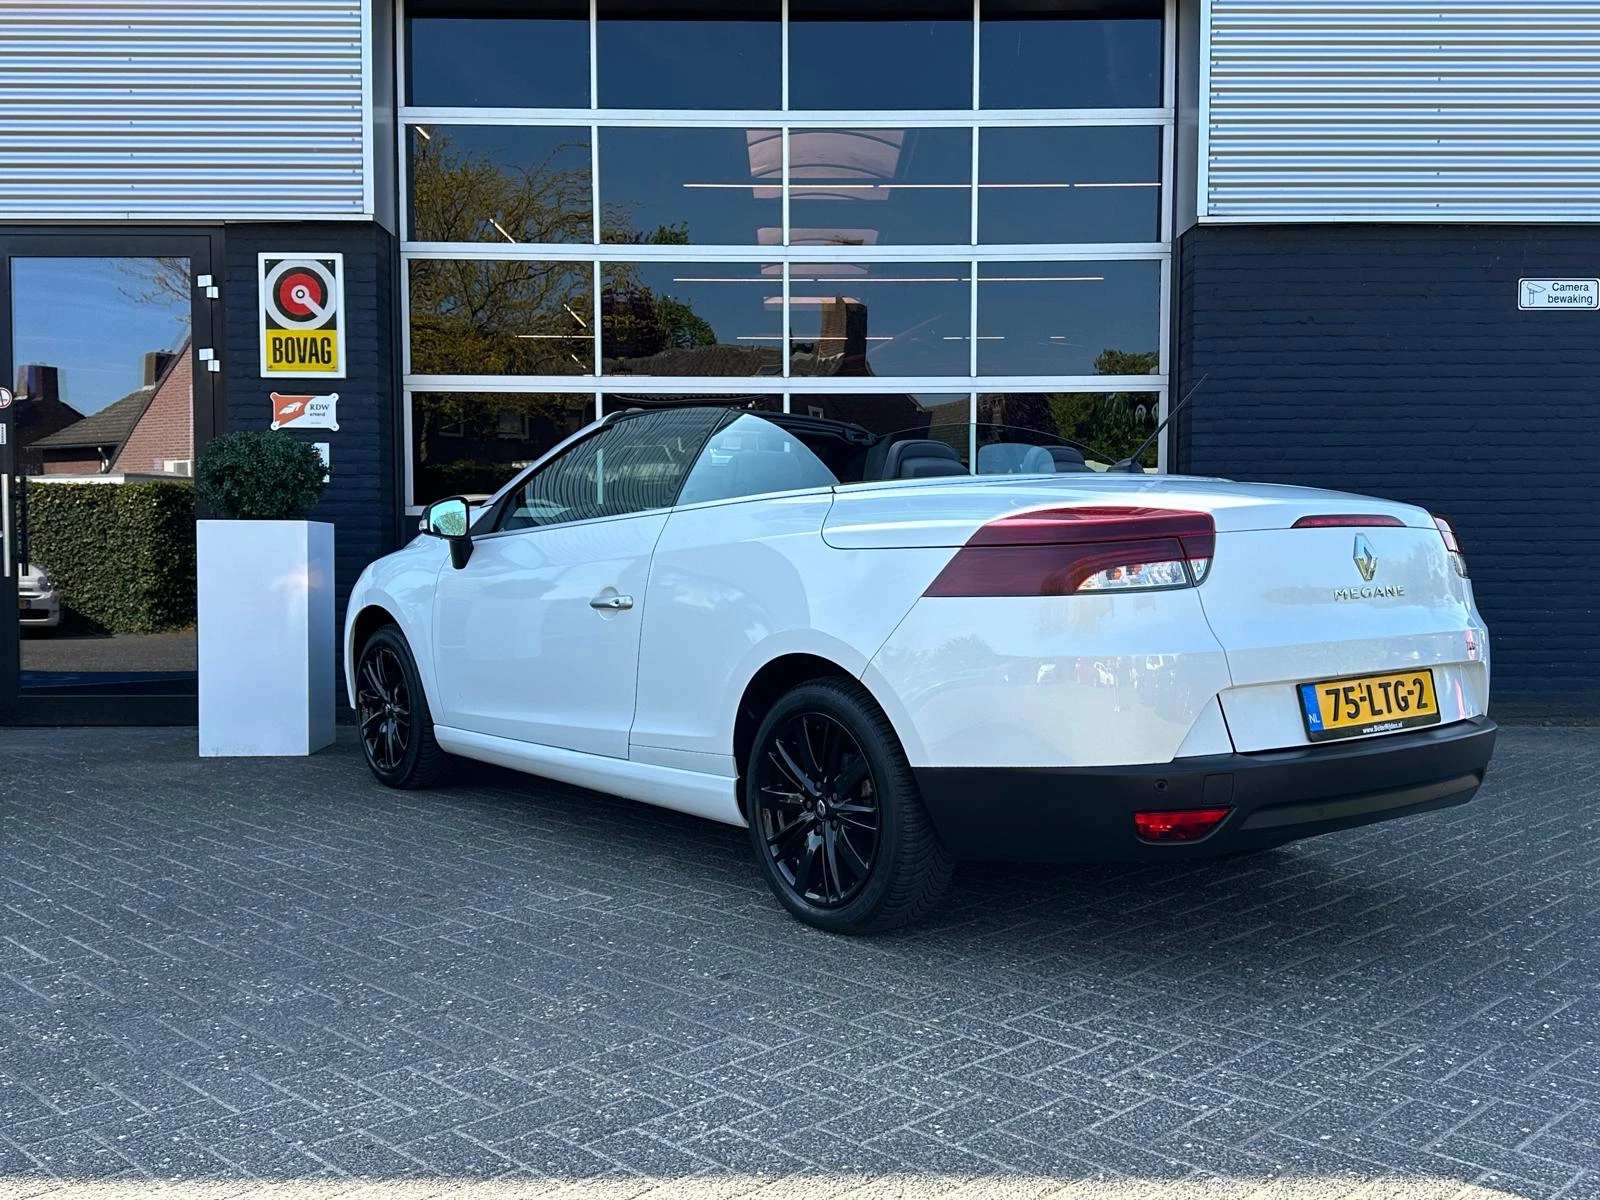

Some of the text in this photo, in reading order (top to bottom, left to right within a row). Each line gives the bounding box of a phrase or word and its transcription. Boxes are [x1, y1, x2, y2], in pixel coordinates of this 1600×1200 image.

[1552, 283, 1589, 291] Camera
[1547, 294, 1593, 305] bewaking
[272, 337, 332, 364] BOVAG
[309, 403, 330, 411] RDW
[1333, 585, 1405, 601] MEGANE
[1325, 678, 1428, 722] 75-LTG-2
[1308, 713, 1320, 724] NL
